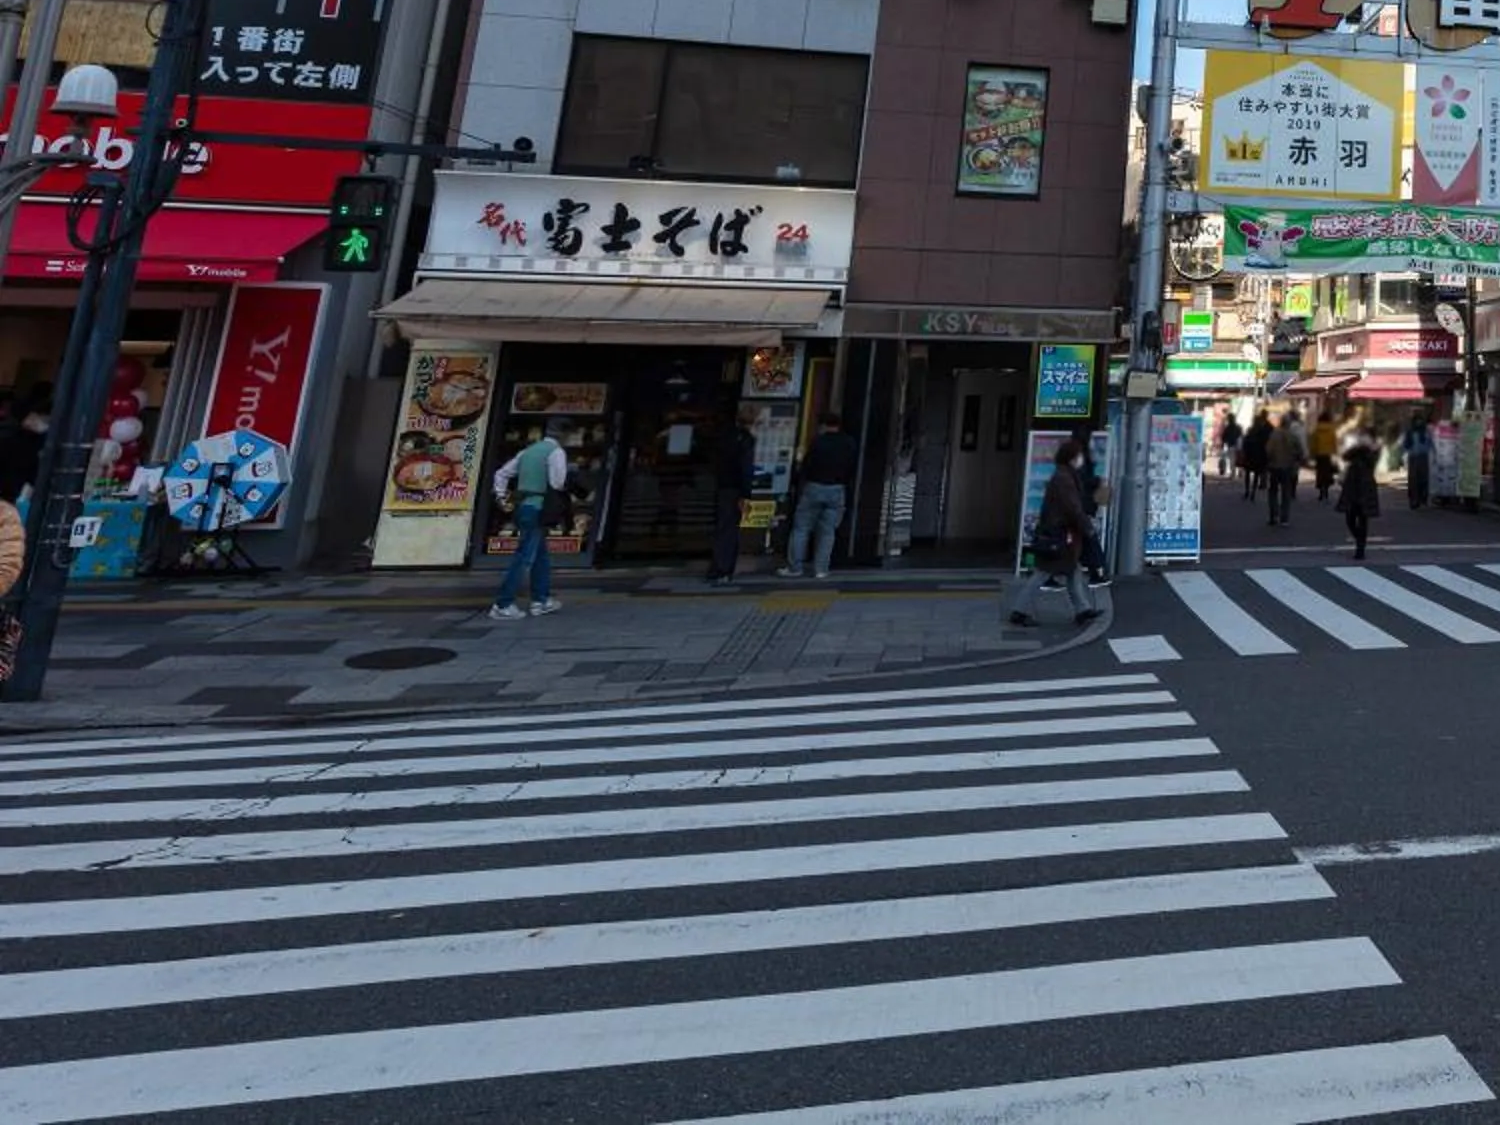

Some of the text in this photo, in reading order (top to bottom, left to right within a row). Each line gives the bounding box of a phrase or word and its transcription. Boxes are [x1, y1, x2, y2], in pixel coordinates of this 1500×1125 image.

[201, 57, 361, 90] 入って左側
[1281, 82, 1330, 99] 本当に
[1238, 97, 1372, 120] 住みやすい街大賞
[1287, 118, 1321, 131] 2019
[1289, 135, 1368, 169] 赤羽
[476, 198, 810, 258] 名代 富士そば 24
[927, 313, 978, 333] KSY
